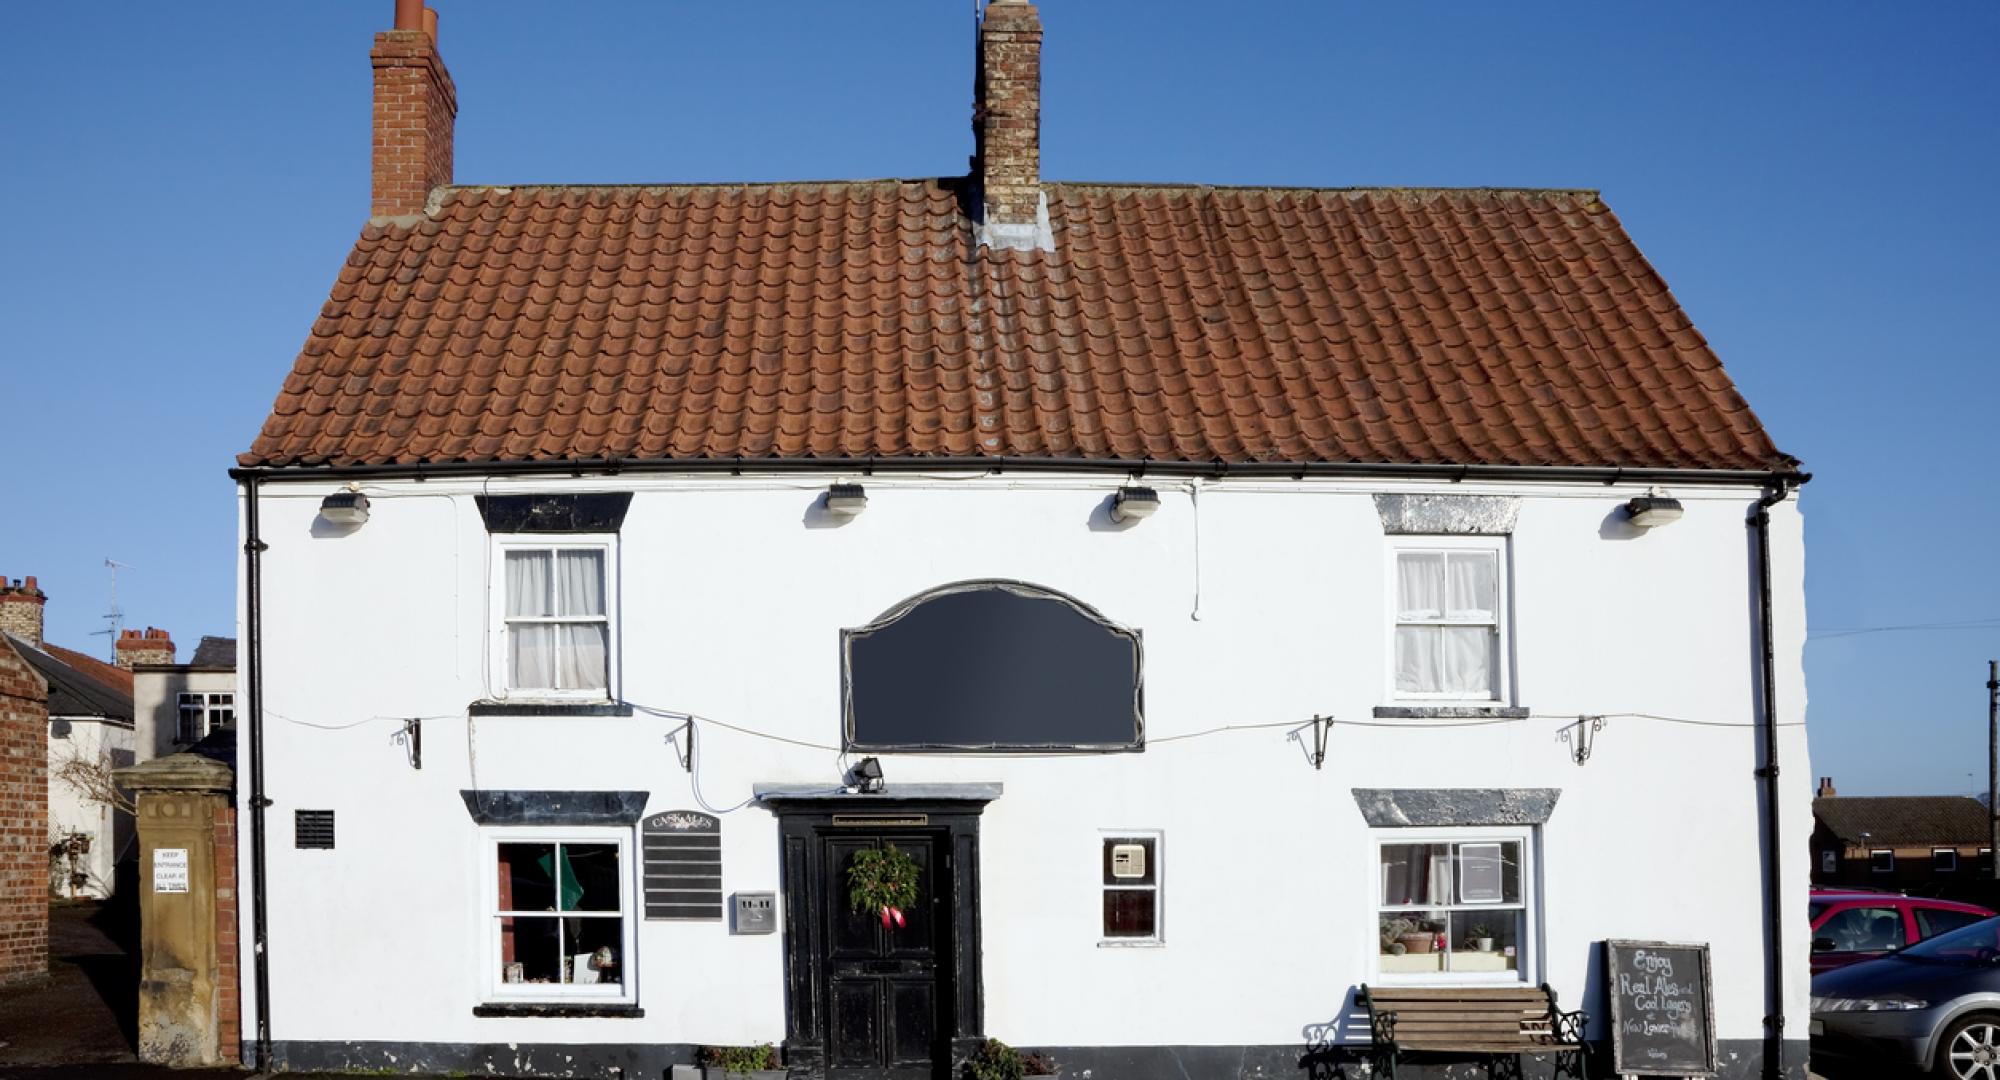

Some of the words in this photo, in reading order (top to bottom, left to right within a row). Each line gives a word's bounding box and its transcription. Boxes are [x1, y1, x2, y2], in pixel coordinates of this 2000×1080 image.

[685, 813, 713, 828] ALES
[1633, 950, 1673, 977] Enjoy
[1619, 973, 1651, 996] Real
[1654, 975, 1678, 997] Ales
[1634, 994, 1658, 1011] Cool
[1660, 996, 1691, 1020] Lagers
[1623, 1018, 1642, 1034] New
